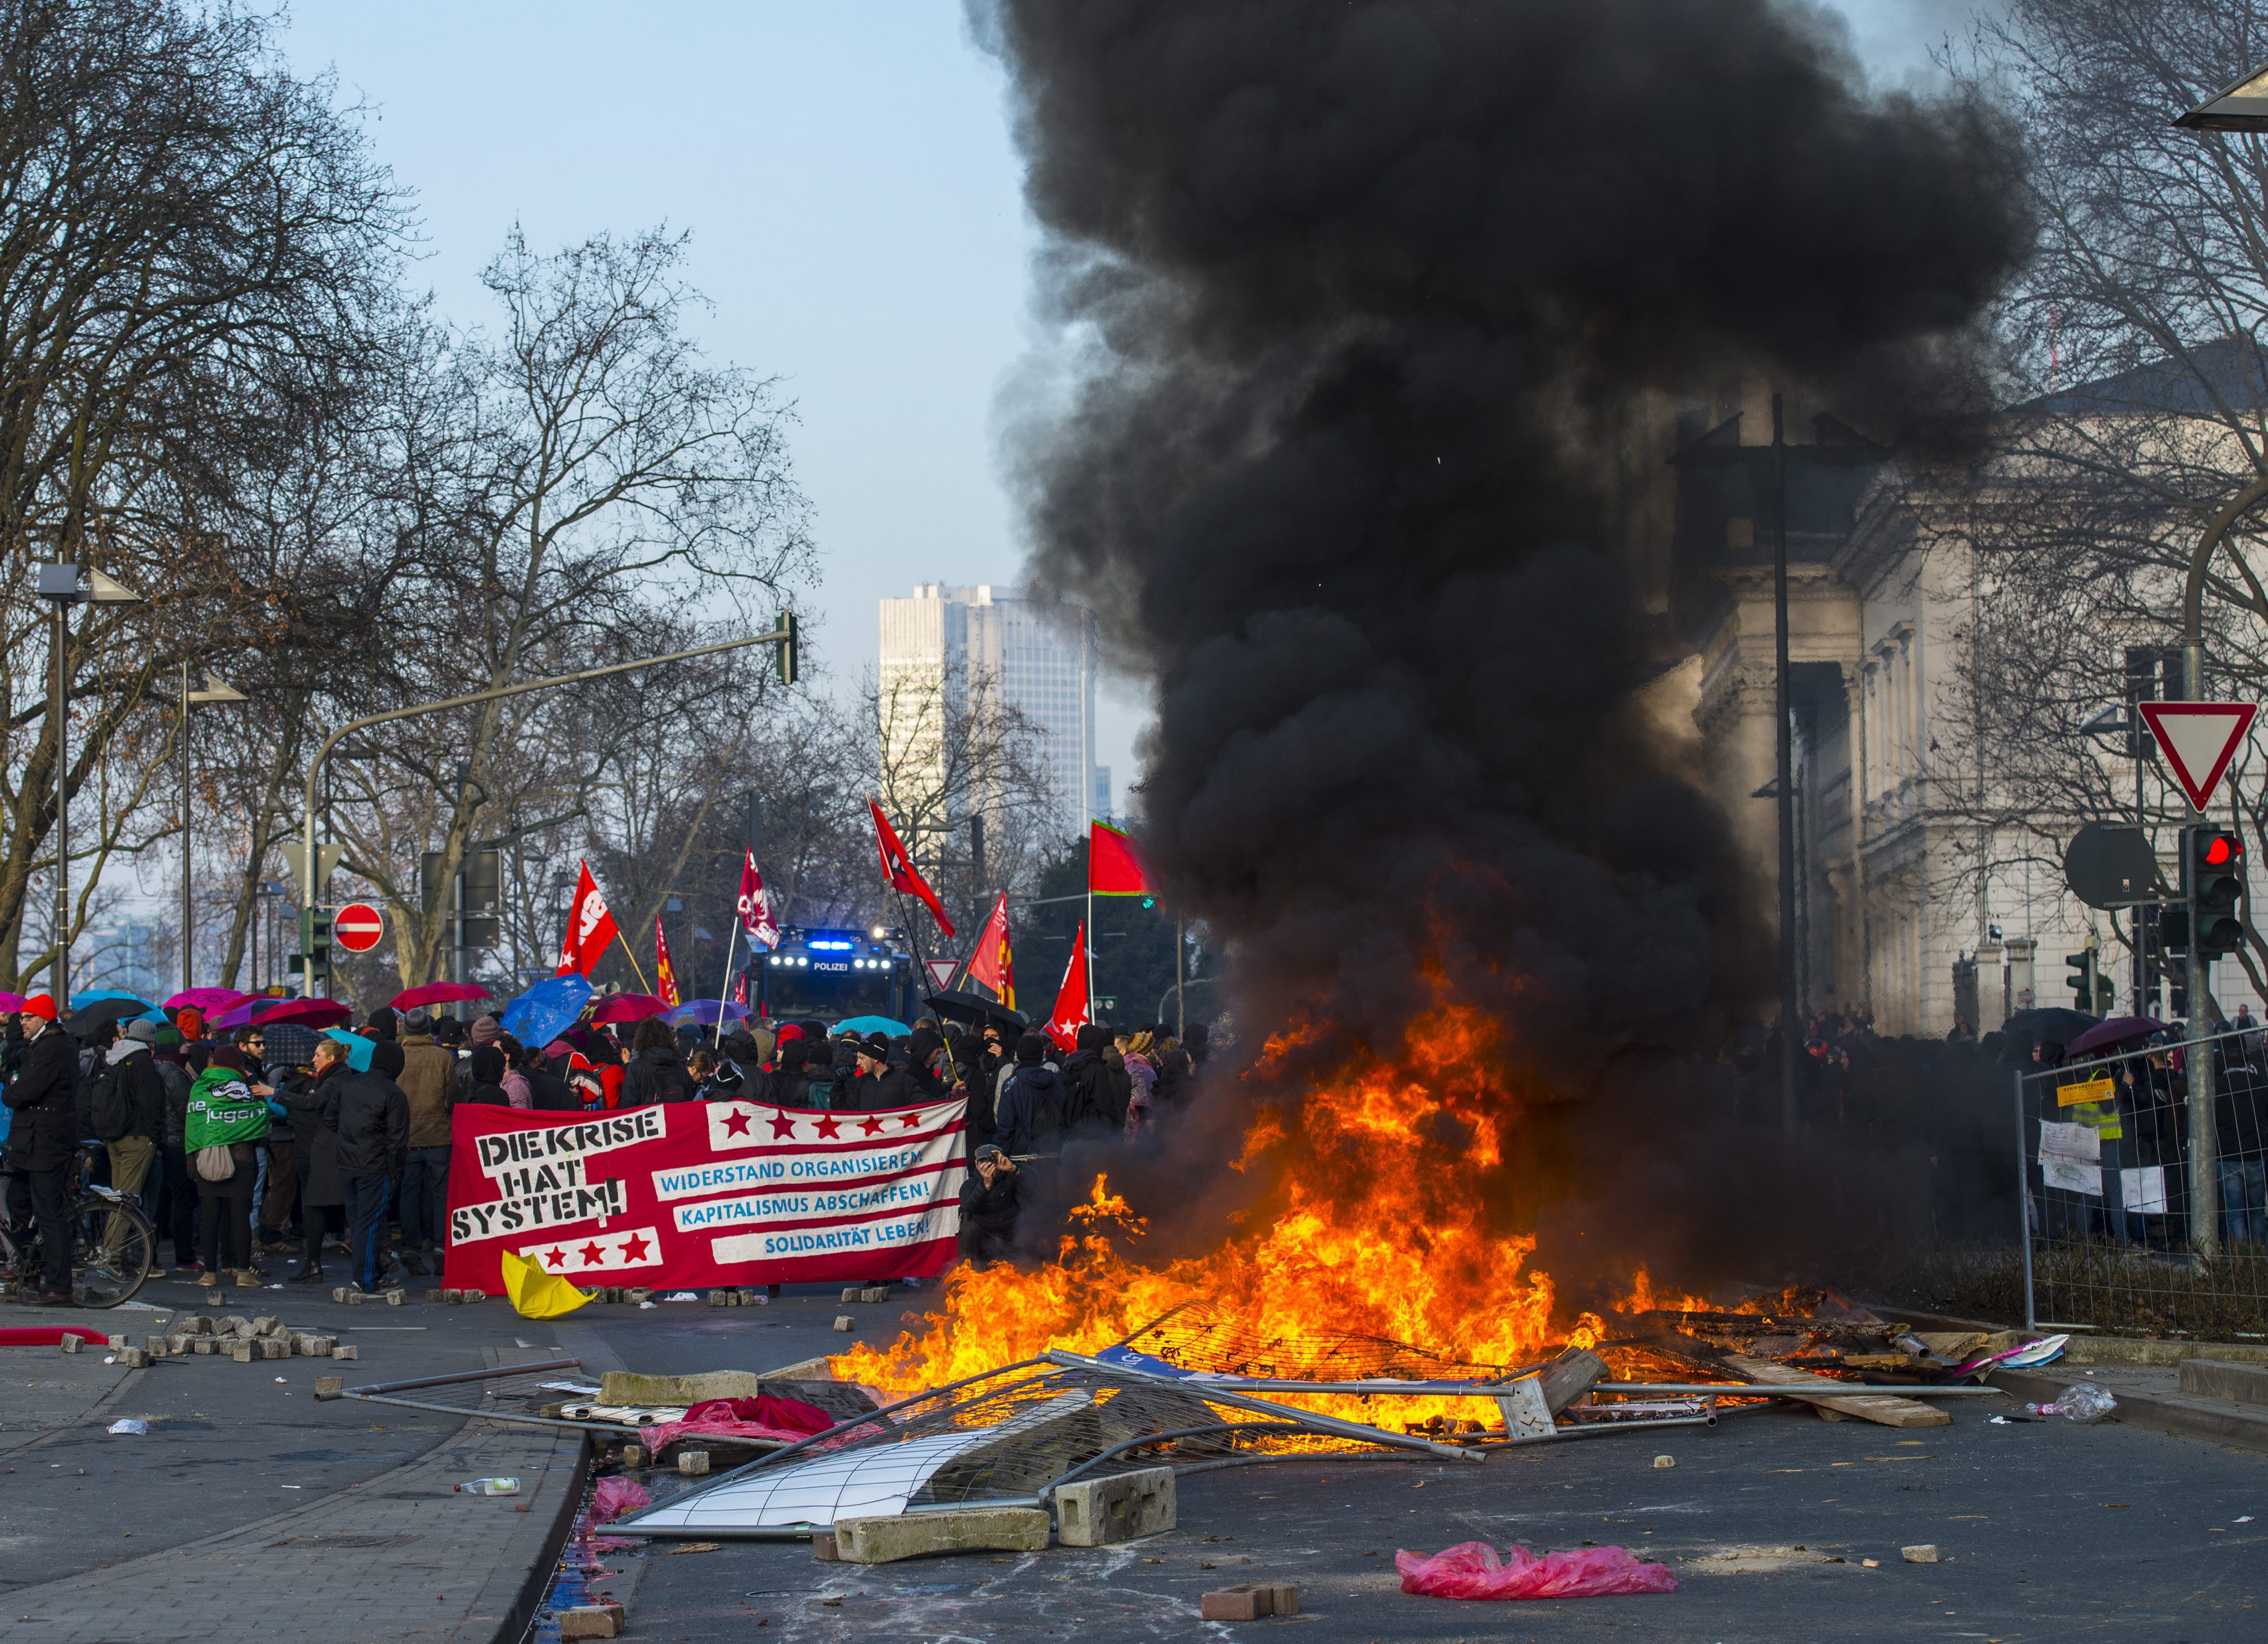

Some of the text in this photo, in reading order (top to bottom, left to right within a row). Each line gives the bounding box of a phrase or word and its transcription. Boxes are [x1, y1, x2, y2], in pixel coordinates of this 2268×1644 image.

[814, 962, 848, 971] POLIZEI
[2064, 1081, 2106, 1092] SCHWARZFELLER
[502, 1159, 581, 1198] HAT
[661, 1150, 924, 1192] WIDERSTAND ORGANISIEREN!
[452, 1177, 621, 1240] SYSTEM!
[682, 1181, 930, 1225] KAPITALISMUS ABSCHAFFEN!
[765, 1218, 930, 1254] SOLIDARITÄT LEBEN!
